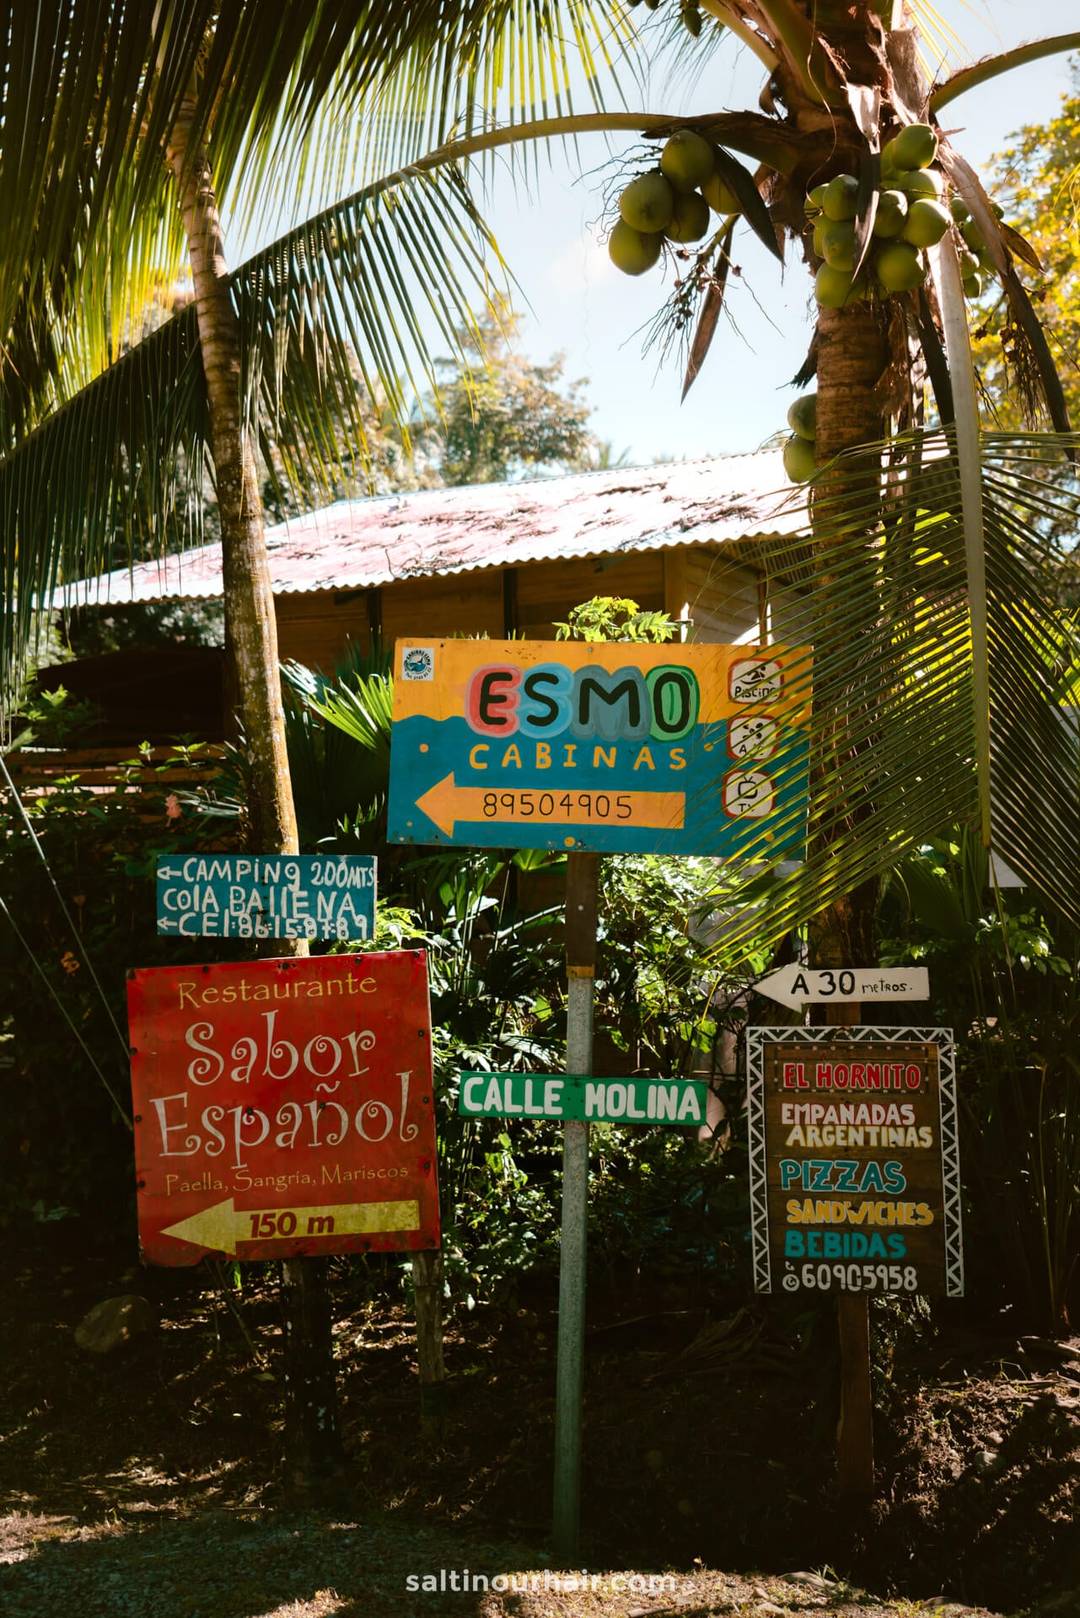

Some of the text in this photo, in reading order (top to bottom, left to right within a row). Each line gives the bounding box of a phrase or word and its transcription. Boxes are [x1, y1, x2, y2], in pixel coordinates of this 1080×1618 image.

[477, 669, 694, 735] ESMO
[469, 742, 688, 771] CABINAS
[482, 792, 633, 819] 89504905
[177, 973, 378, 1010] Restaurante
[790, 973, 810, 995] A
[818, 971, 856, 996] 30
[184, 1009, 377, 1086] Sabor
[783, 1062, 921, 1090] EL HORNITO
[463, 1077, 702, 1121] CALLE MOLINA
[149, 1070, 420, 1170] Español
[781, 1103, 916, 1126] EMPANADAS
[785, 1125, 934, 1148] ARGENTINAS
[166, 1172, 230, 1196] Paella,
[321, 1164, 409, 1186] Mariscos
[778, 1158, 907, 1195] PIZZAS
[249, 1211, 335, 1238] 150 m
[786, 1198, 935, 1226] SANDWICHES
[783, 1229, 908, 1259] BEBIDAS
[801, 1263, 919, 1292] 60905958
